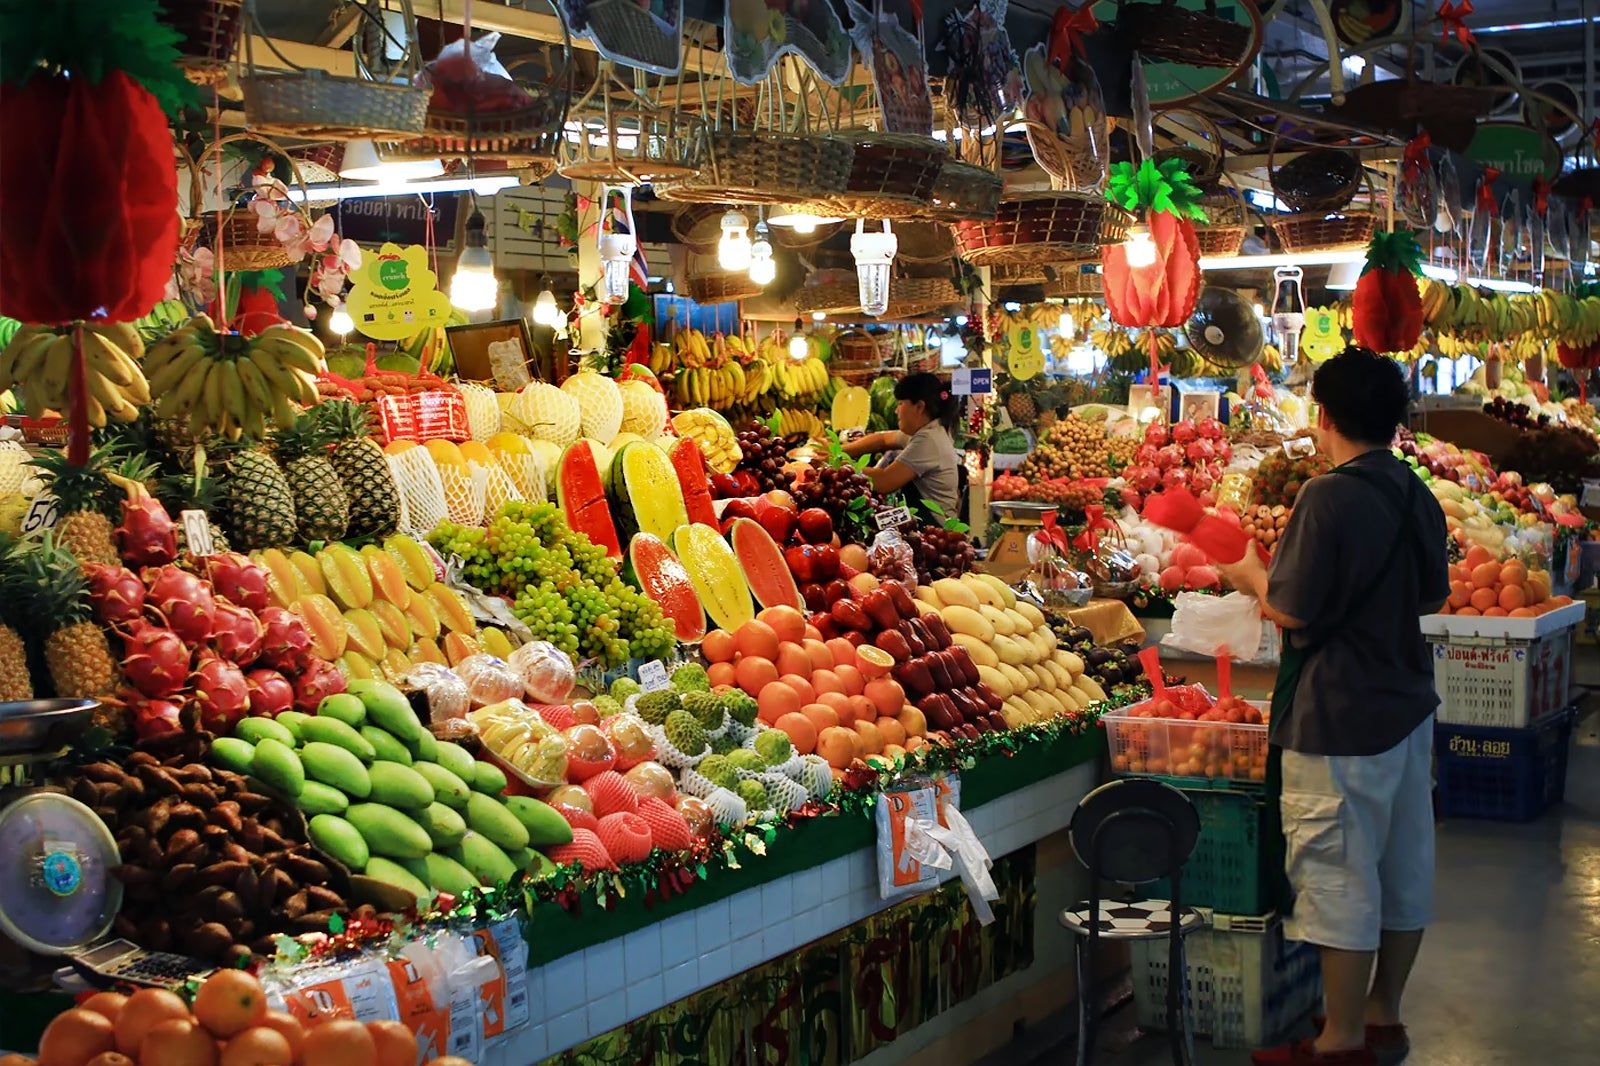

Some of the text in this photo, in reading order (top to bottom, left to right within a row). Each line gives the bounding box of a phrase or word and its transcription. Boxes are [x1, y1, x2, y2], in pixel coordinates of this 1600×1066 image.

[972, 376, 990, 386] OPEN
[25, 498, 59, 532] 50
[187, 514, 214, 555] 60
